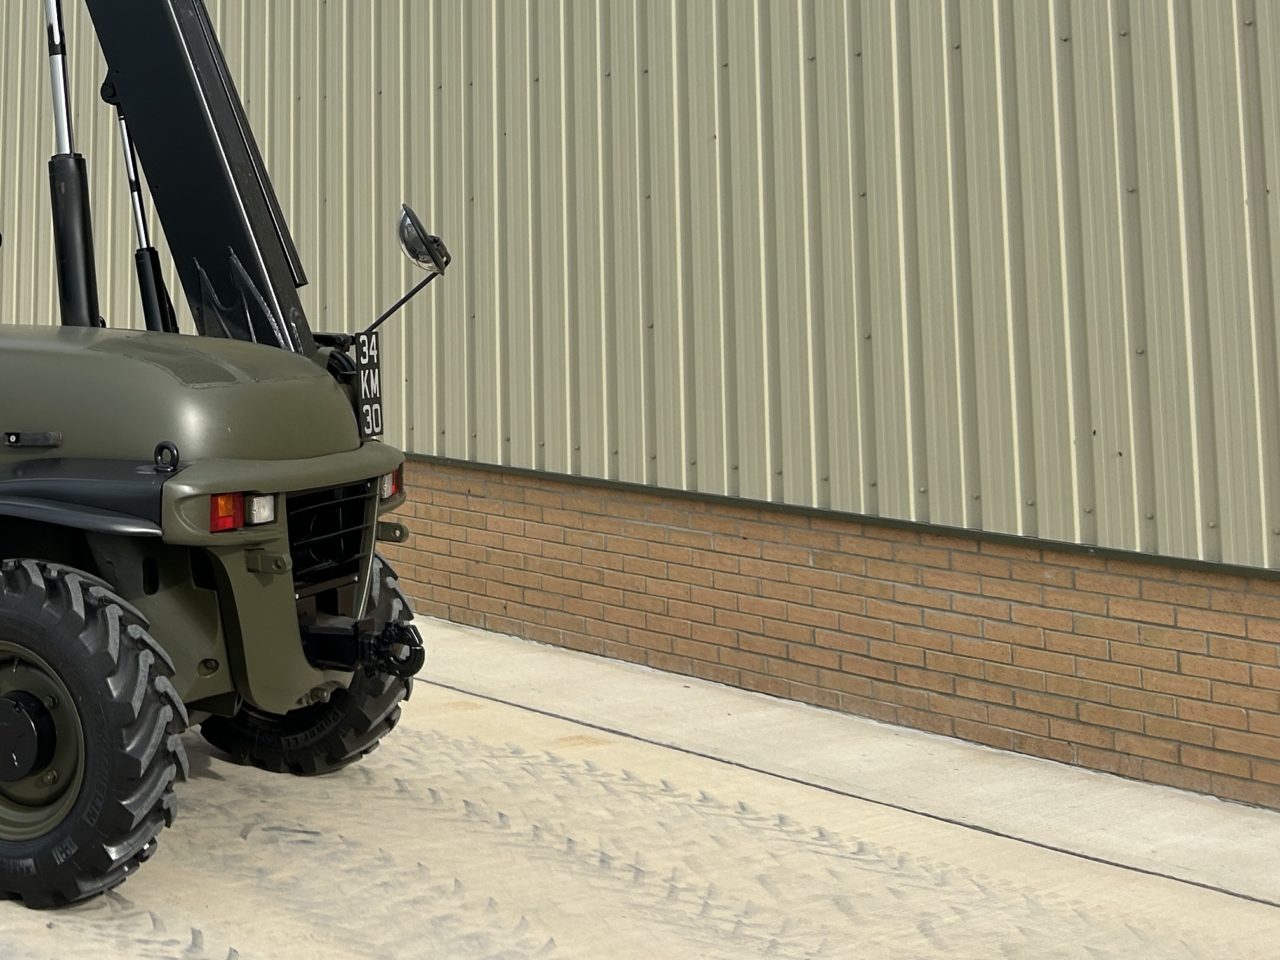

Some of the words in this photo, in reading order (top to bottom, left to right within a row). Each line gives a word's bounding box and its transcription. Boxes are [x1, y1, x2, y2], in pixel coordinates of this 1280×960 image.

[359, 334, 378, 365] 34
[360, 368, 380, 399] KM
[362, 403, 382, 434] 30
